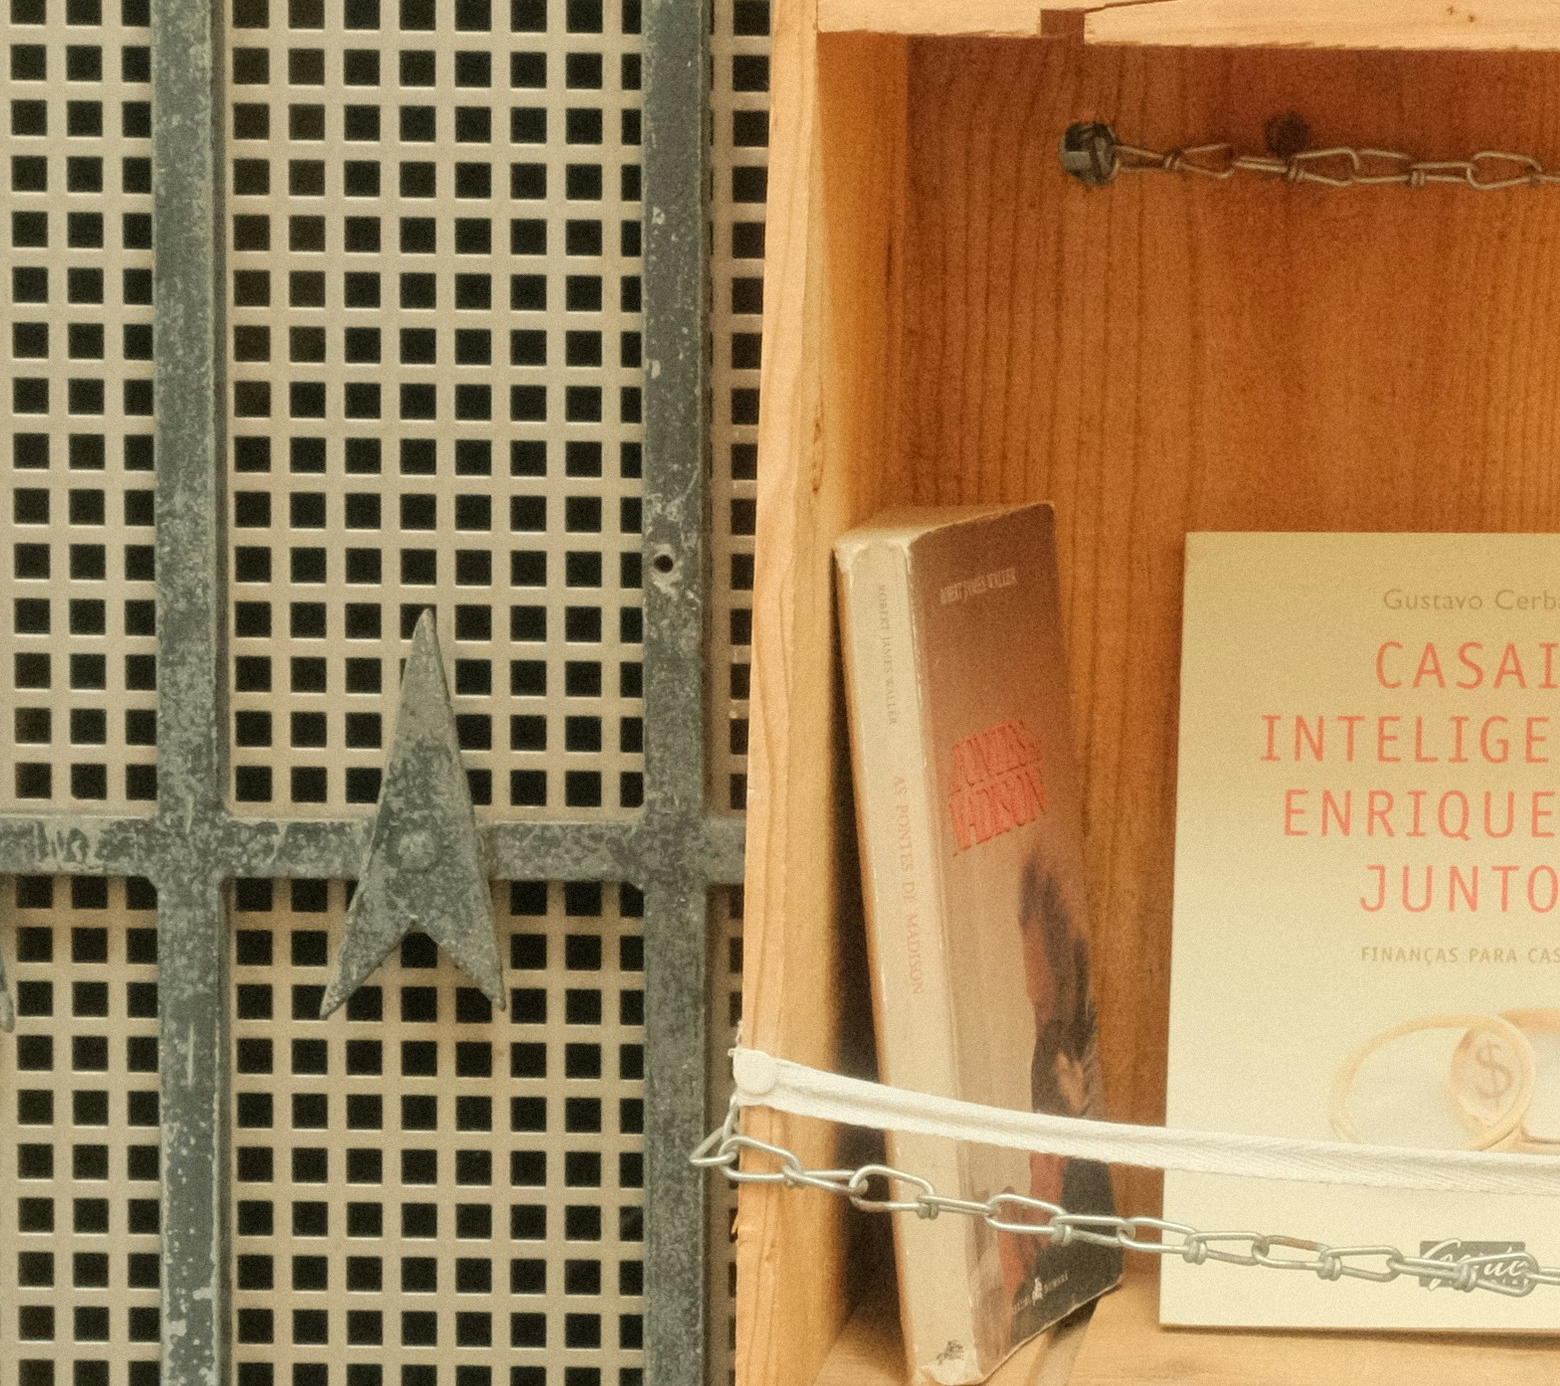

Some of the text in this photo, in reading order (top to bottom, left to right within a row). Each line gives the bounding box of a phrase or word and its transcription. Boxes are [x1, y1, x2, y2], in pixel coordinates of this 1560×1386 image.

[1382, 589, 1484, 611] Gustavo
[881, 634, 894, 674] JAMES
[885, 677, 899, 726] WALLER
[895, 803, 915, 873] PONTES
[902, 880, 917, 907] DE
[906, 913, 925, 995] MADISON
[1361, 947, 1459, 967] FINANÇAS
[1469, 948, 1518, 964] PARA
